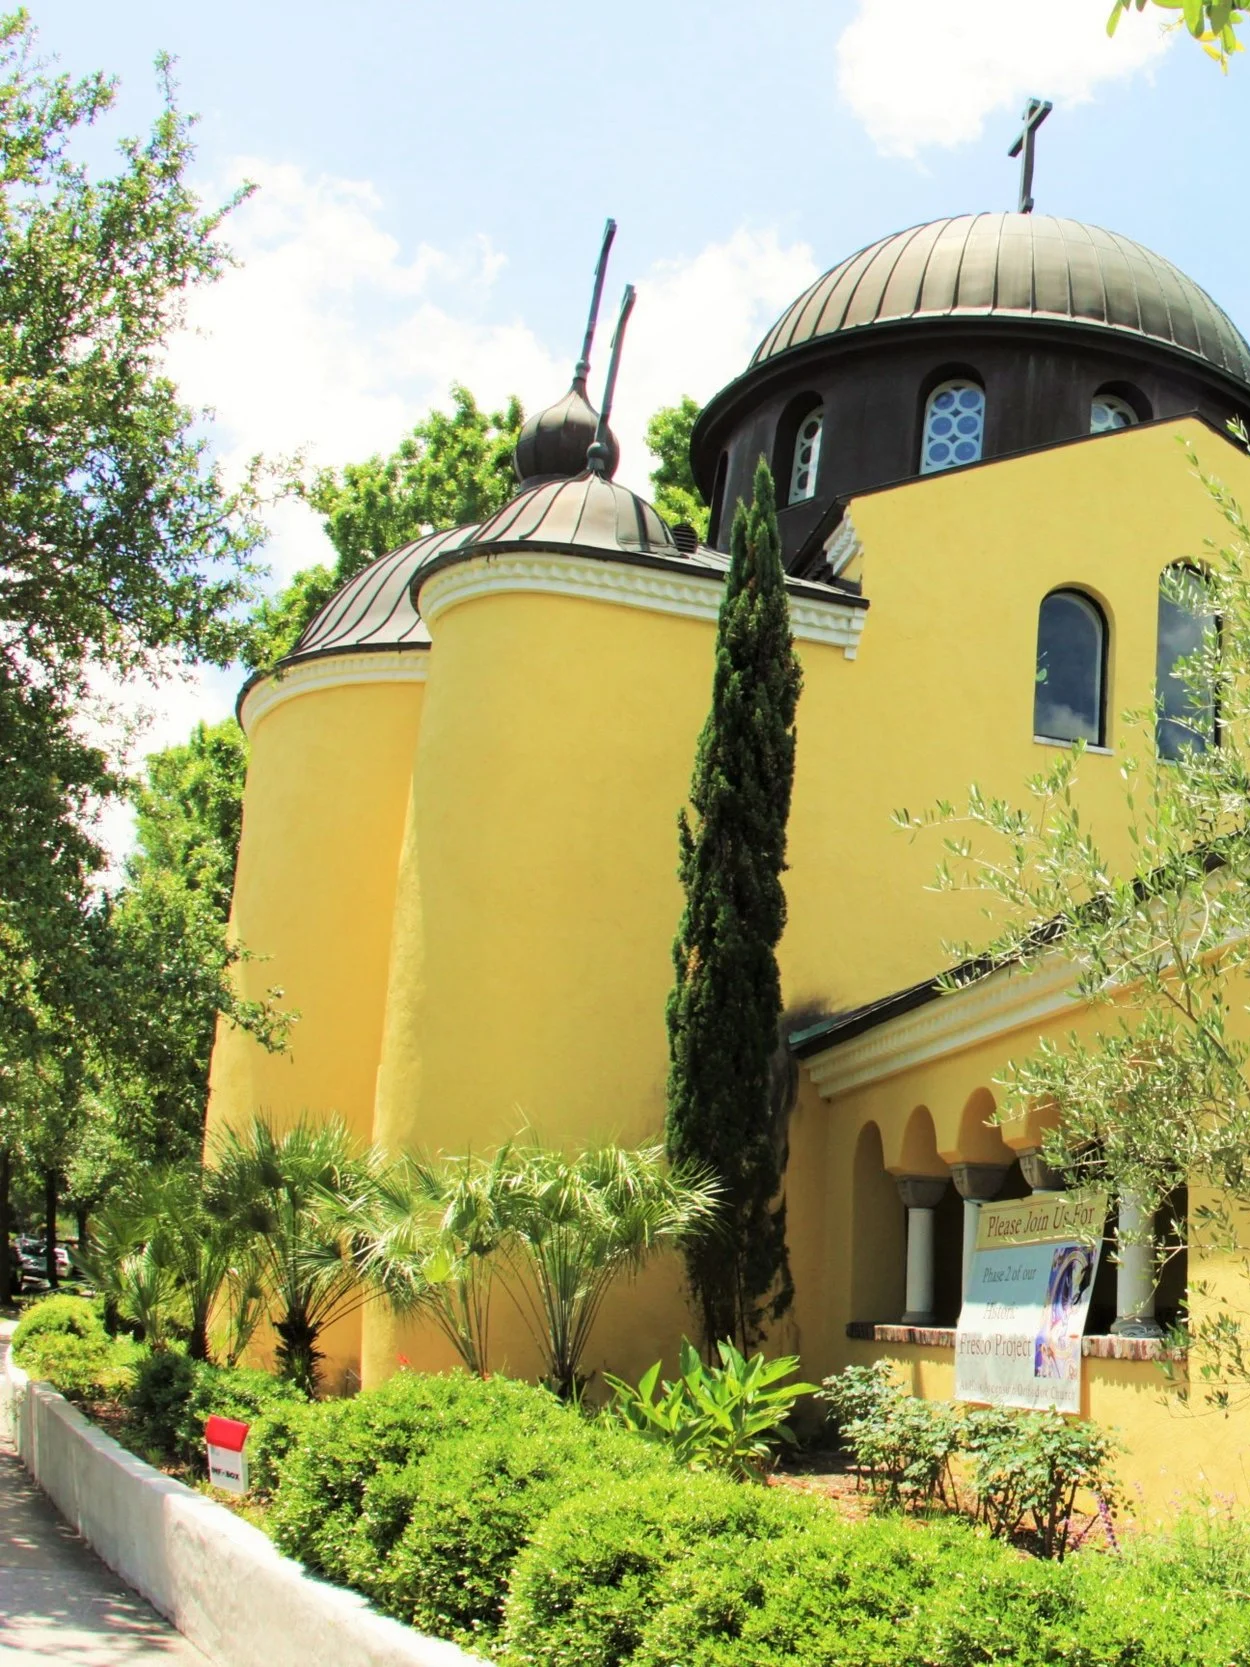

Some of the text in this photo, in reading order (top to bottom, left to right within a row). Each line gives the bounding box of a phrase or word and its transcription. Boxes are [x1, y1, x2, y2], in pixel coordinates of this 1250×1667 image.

[987, 1203, 1096, 1238] Please Join Us For
[982, 1264, 1037, 1284] Phase 2 of our
[959, 1333, 1032, 1363] Fresco Project
